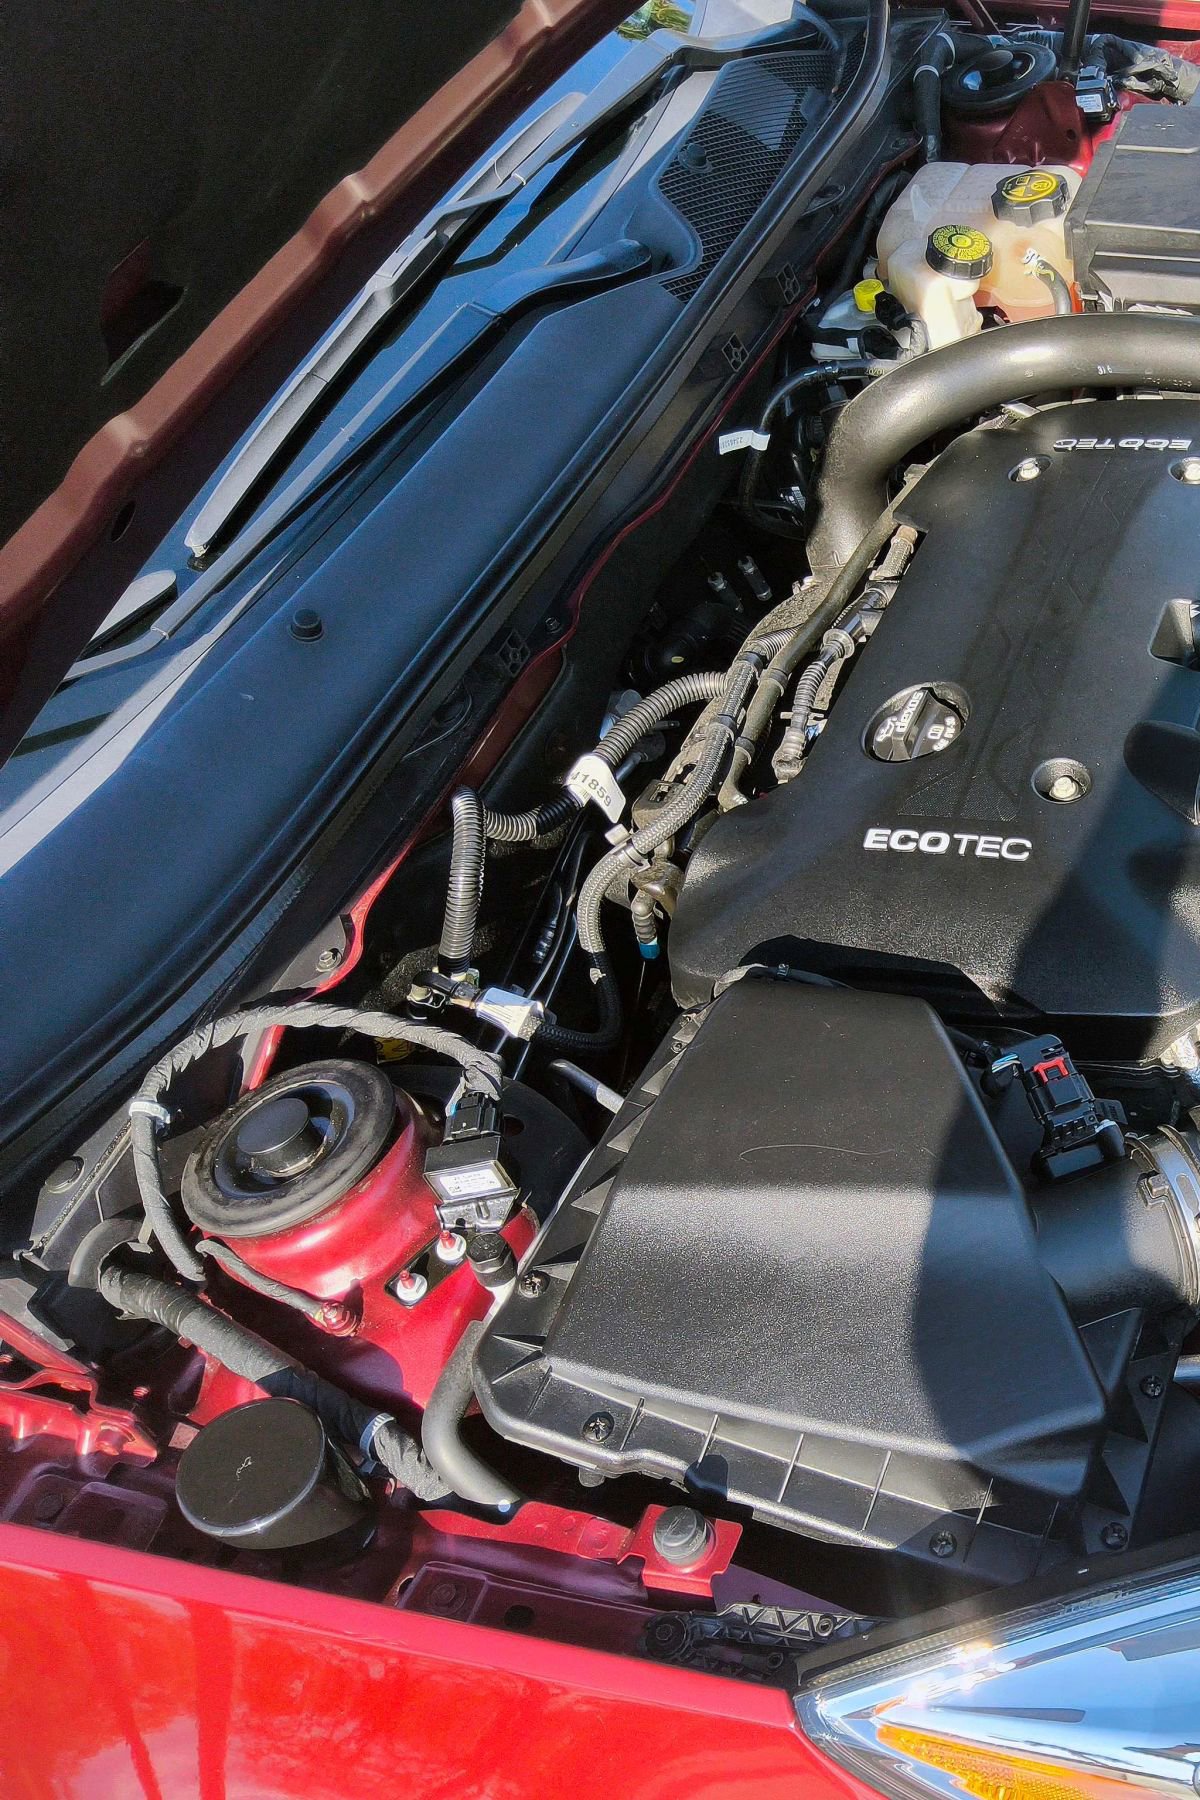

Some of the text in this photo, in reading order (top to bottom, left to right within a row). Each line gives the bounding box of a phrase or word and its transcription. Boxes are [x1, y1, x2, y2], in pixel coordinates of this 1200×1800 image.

[1053, 438, 1192, 452] ECOTEC
[895, 691, 924, 733] dexos
[863, 827, 1033, 862] ECOTEC
